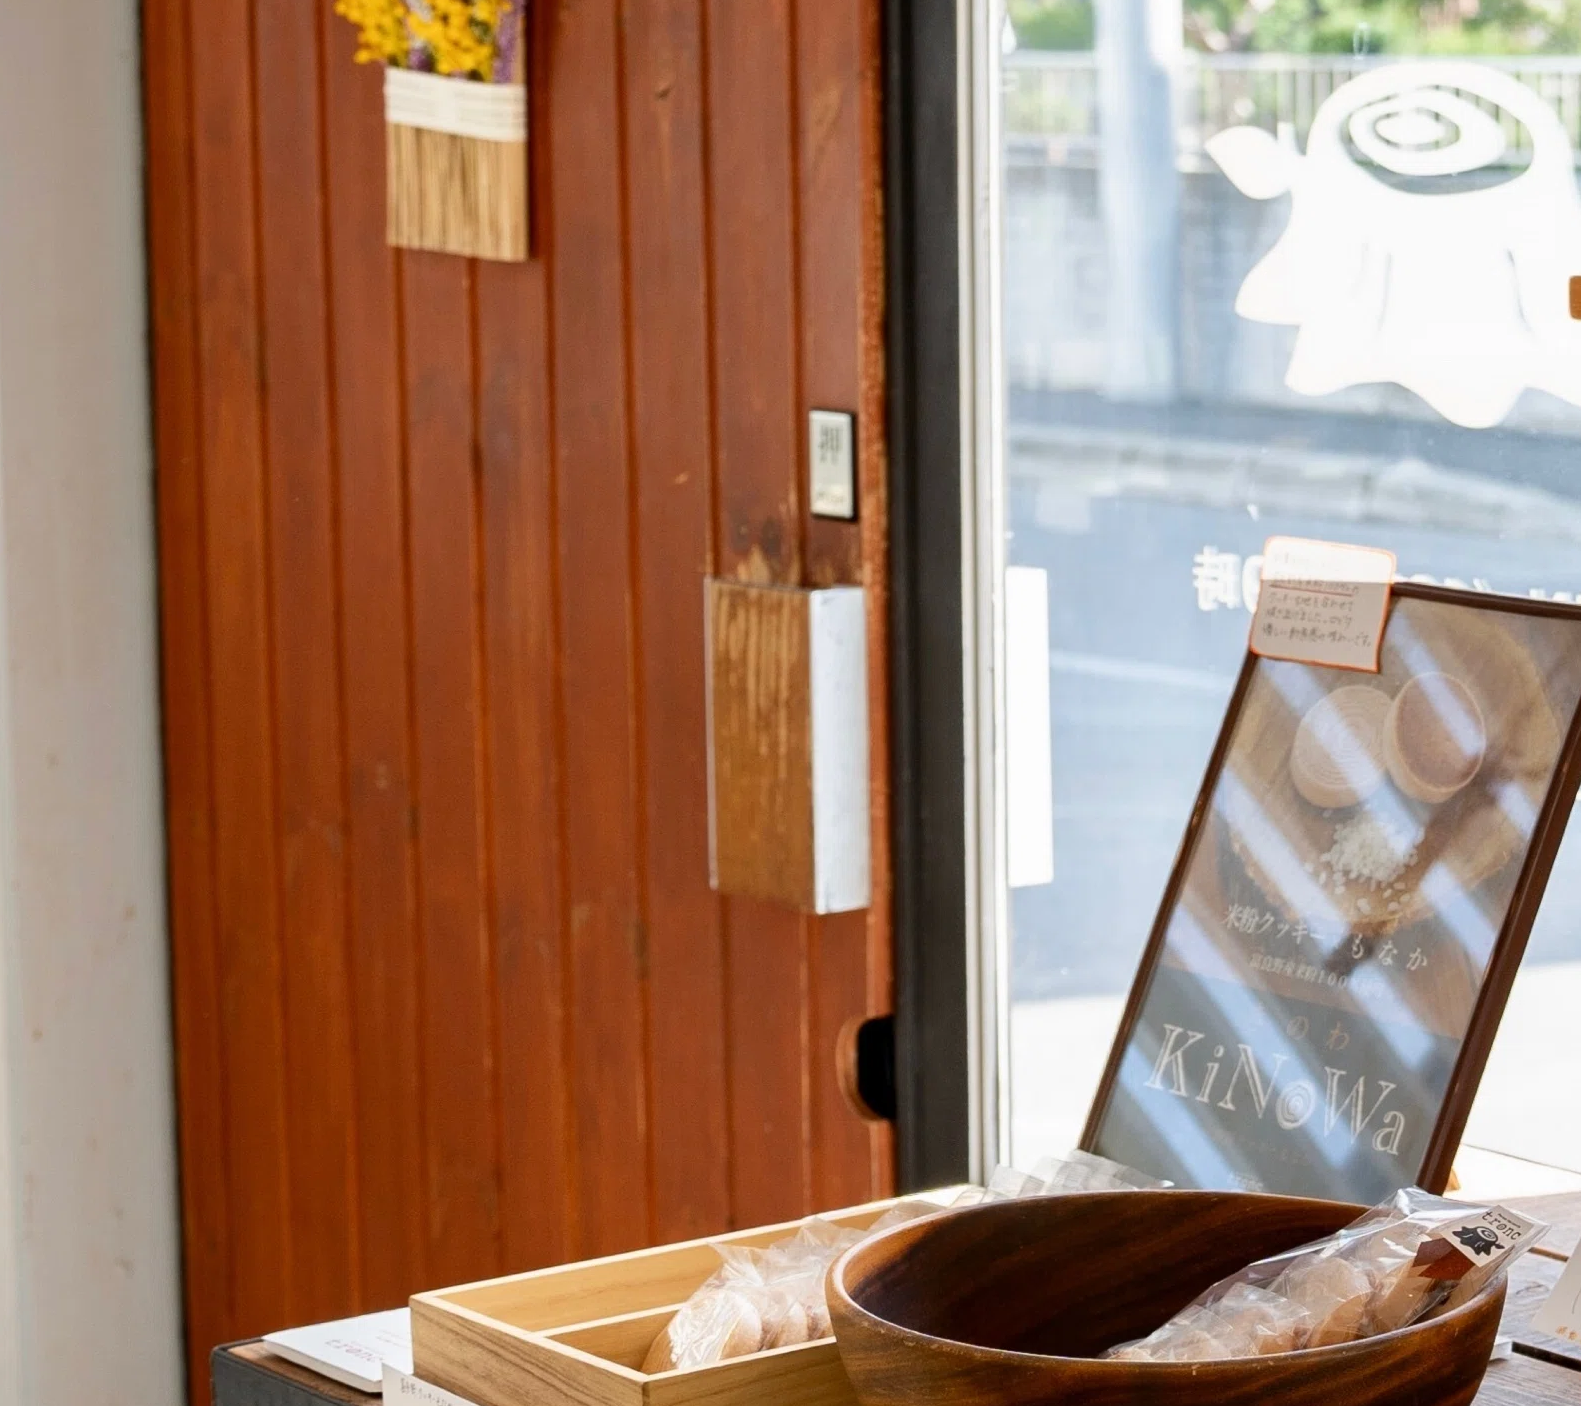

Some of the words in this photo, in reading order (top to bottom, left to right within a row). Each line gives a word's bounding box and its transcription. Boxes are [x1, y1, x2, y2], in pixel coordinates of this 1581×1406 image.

[1223, 903, 1324, 943] 米粉クッキー
[1352, 934, 1427, 971] もなか
[1482, 1211, 1521, 1240] tronc
